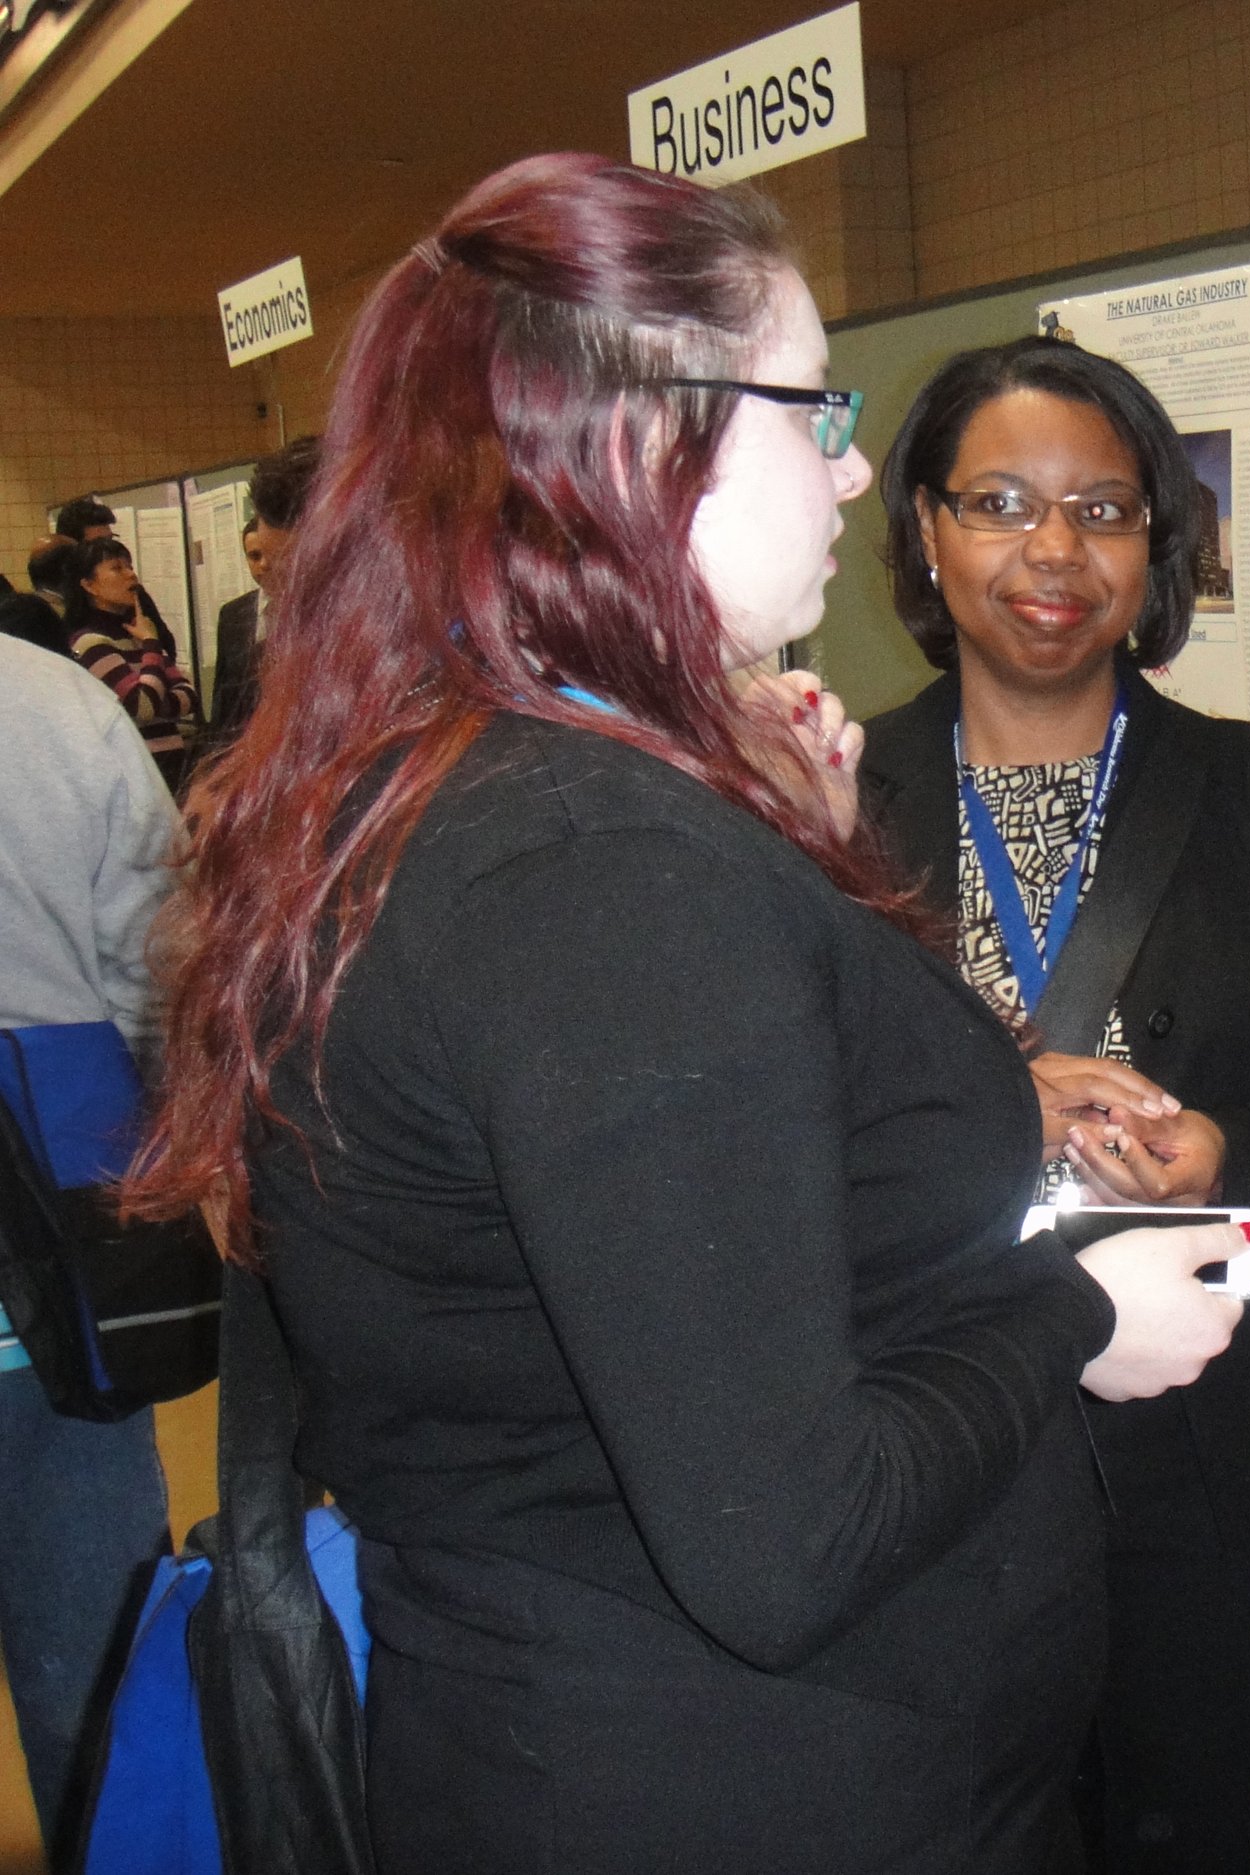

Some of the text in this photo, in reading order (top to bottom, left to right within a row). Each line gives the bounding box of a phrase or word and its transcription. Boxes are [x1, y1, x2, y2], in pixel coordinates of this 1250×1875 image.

[651, 56, 835, 175] Business
[223, 283, 307, 350] Economics
[1107, 278, 1248, 317] THE NATURAL GAS INDUSTRY
